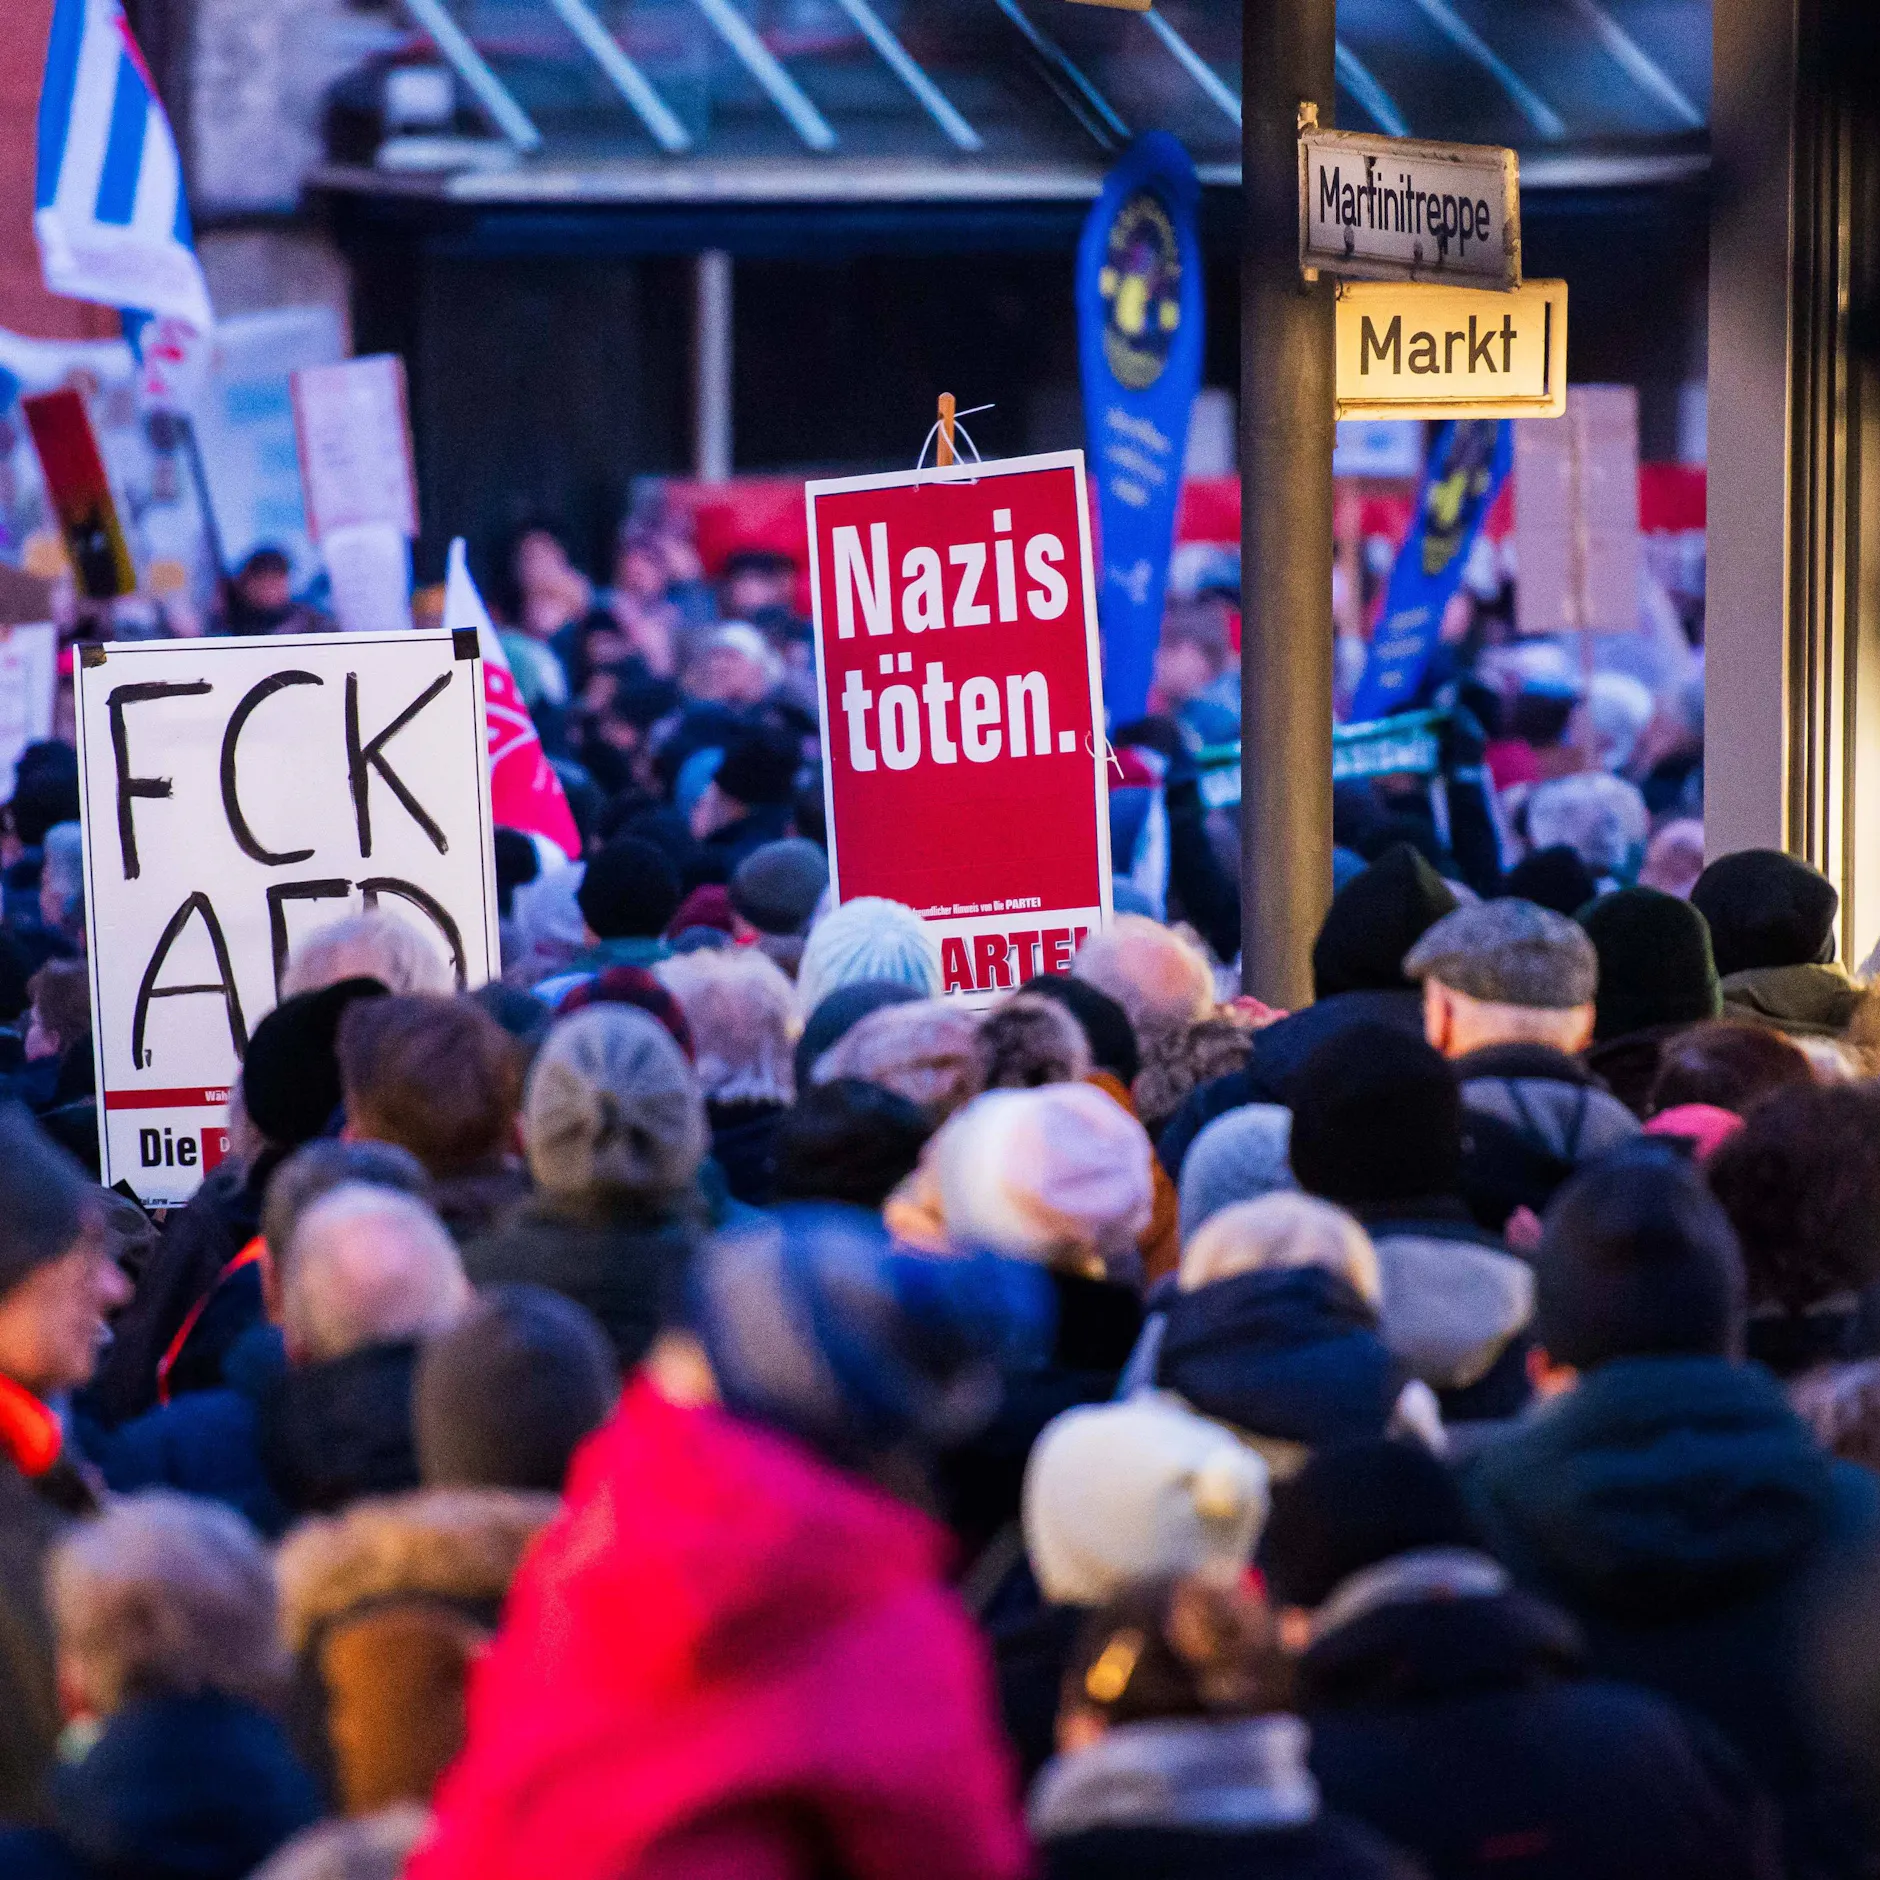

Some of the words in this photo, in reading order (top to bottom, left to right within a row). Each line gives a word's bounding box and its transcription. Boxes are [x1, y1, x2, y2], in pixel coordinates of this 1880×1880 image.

[1319, 165, 1490, 257] Martinitreppe
[1360, 314, 1517, 375] Markt
[832, 508, 1069, 639] Nazis
[842, 652, 1076, 772] töten.
[106, 669, 454, 880] FCK
[953, 903, 979, 914] Hinweis
[980, 902, 992, 911] von
[993, 900, 1005, 910] Die
[1005, 897, 1041, 910] PARTEI
[941, 926, 1089, 992] ARTE
[205, 1090, 231, 1102] Wäh
[139, 1127, 197, 1167] Die
